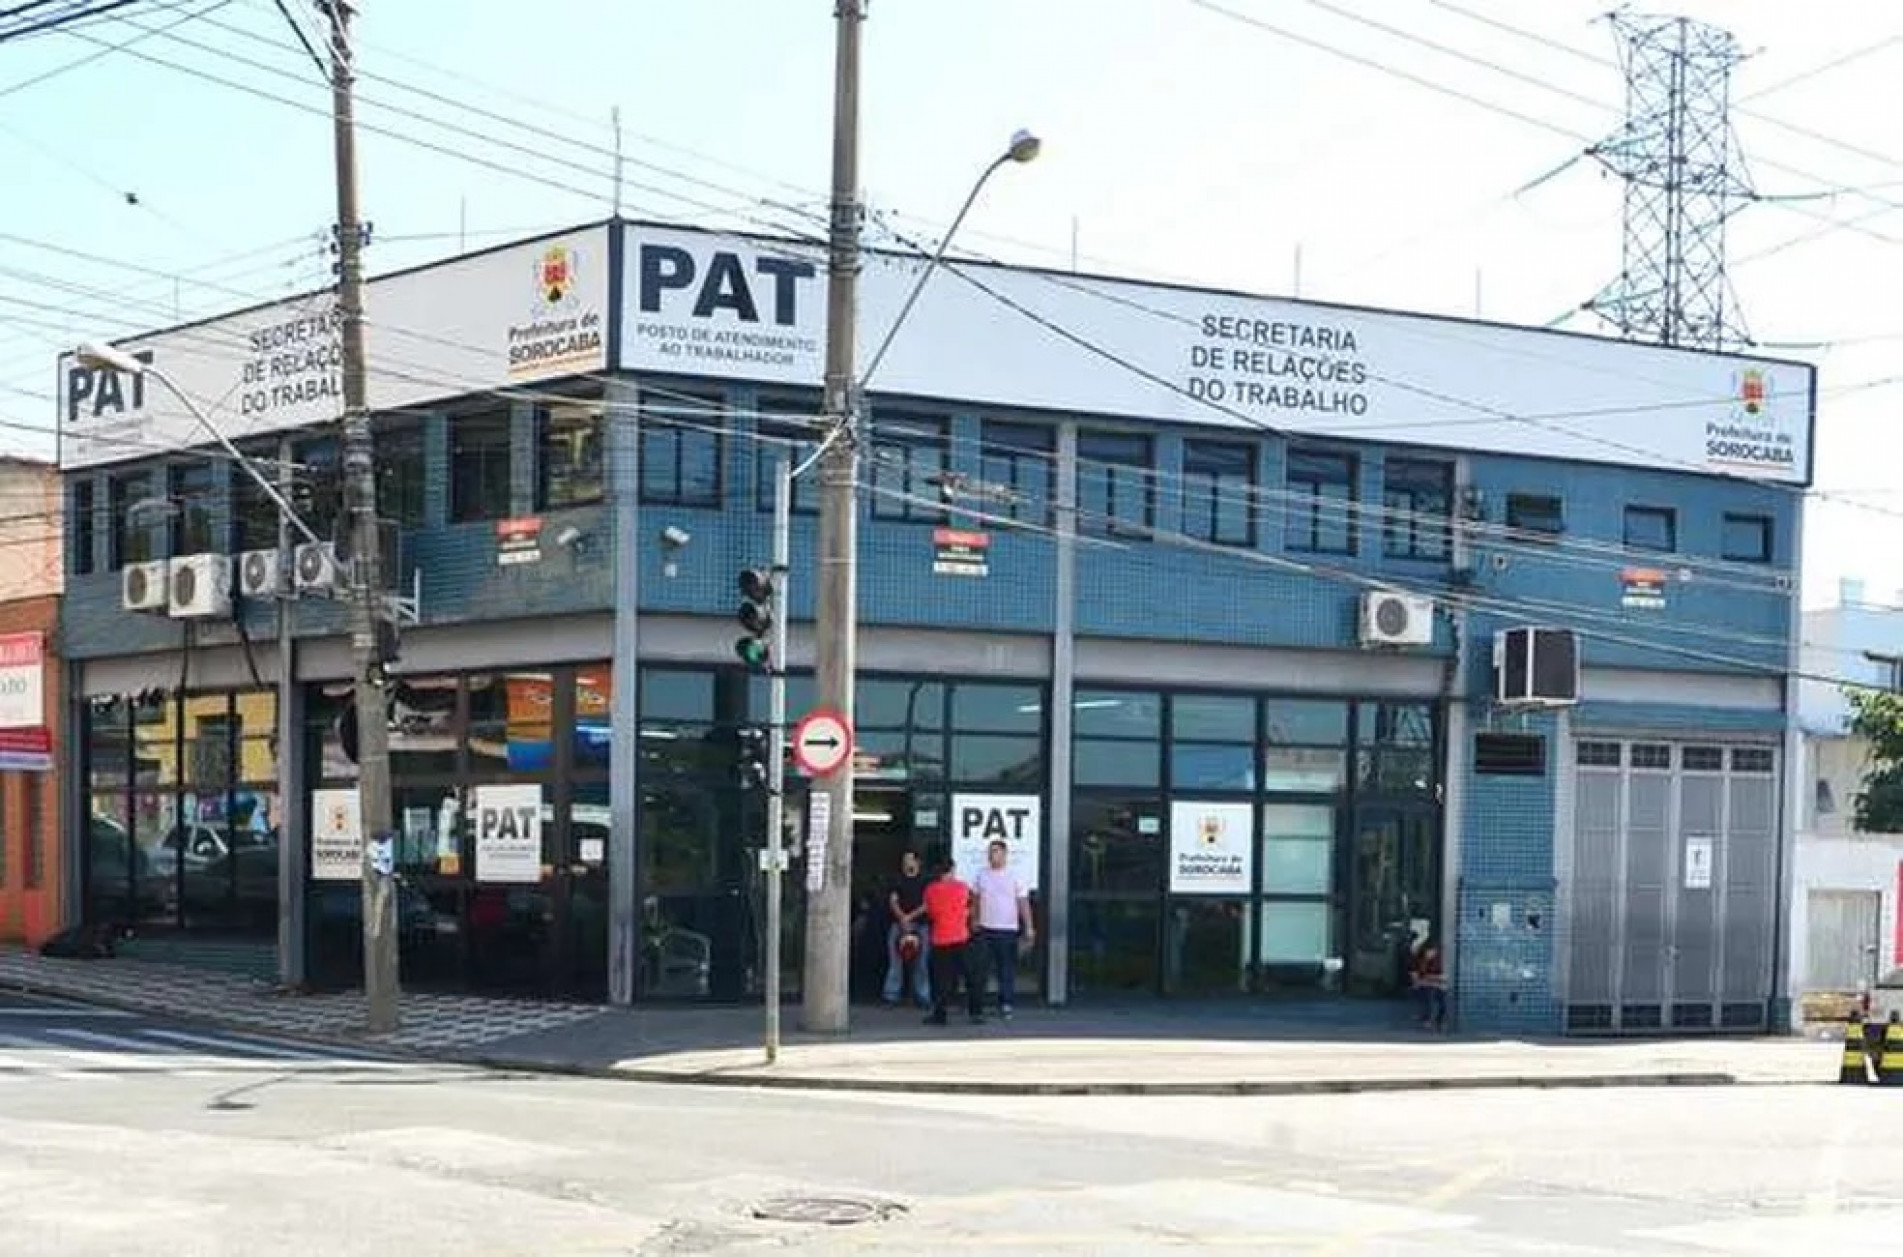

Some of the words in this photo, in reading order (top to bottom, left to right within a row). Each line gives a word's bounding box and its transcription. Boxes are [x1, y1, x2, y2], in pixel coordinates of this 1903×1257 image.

[639, 244, 815, 326] PAT
[249, 309, 342, 352] SECRETAR
[581, 311, 599, 329] de
[637, 323, 688, 342] POSTO
[691, 326, 711, 342] DE
[714, 330, 818, 353] ATENDIMENTO
[1202, 313, 1357, 352] SECRETARIA
[243, 359, 266, 384] DE
[270, 337, 342, 379] RELAÇÕ
[509, 330, 600, 365] SOROCABA
[659, 341, 682, 357] AO
[685, 343, 795, 367] TRABALHADOR
[1191, 345, 1225, 370] DE
[1232, 350, 1367, 385] RELAÇÕES
[68, 350, 153, 422] PAT
[241, 390, 266, 415] DO
[270, 376, 342, 407] TRABAL
[1188, 376, 1226, 402] DO
[1233, 380, 1368, 416] TRABALHO
[1705, 440, 1793, 463] SOROCABA
[481, 805, 537, 840] PAT
[962, 806, 1031, 840] PAT
